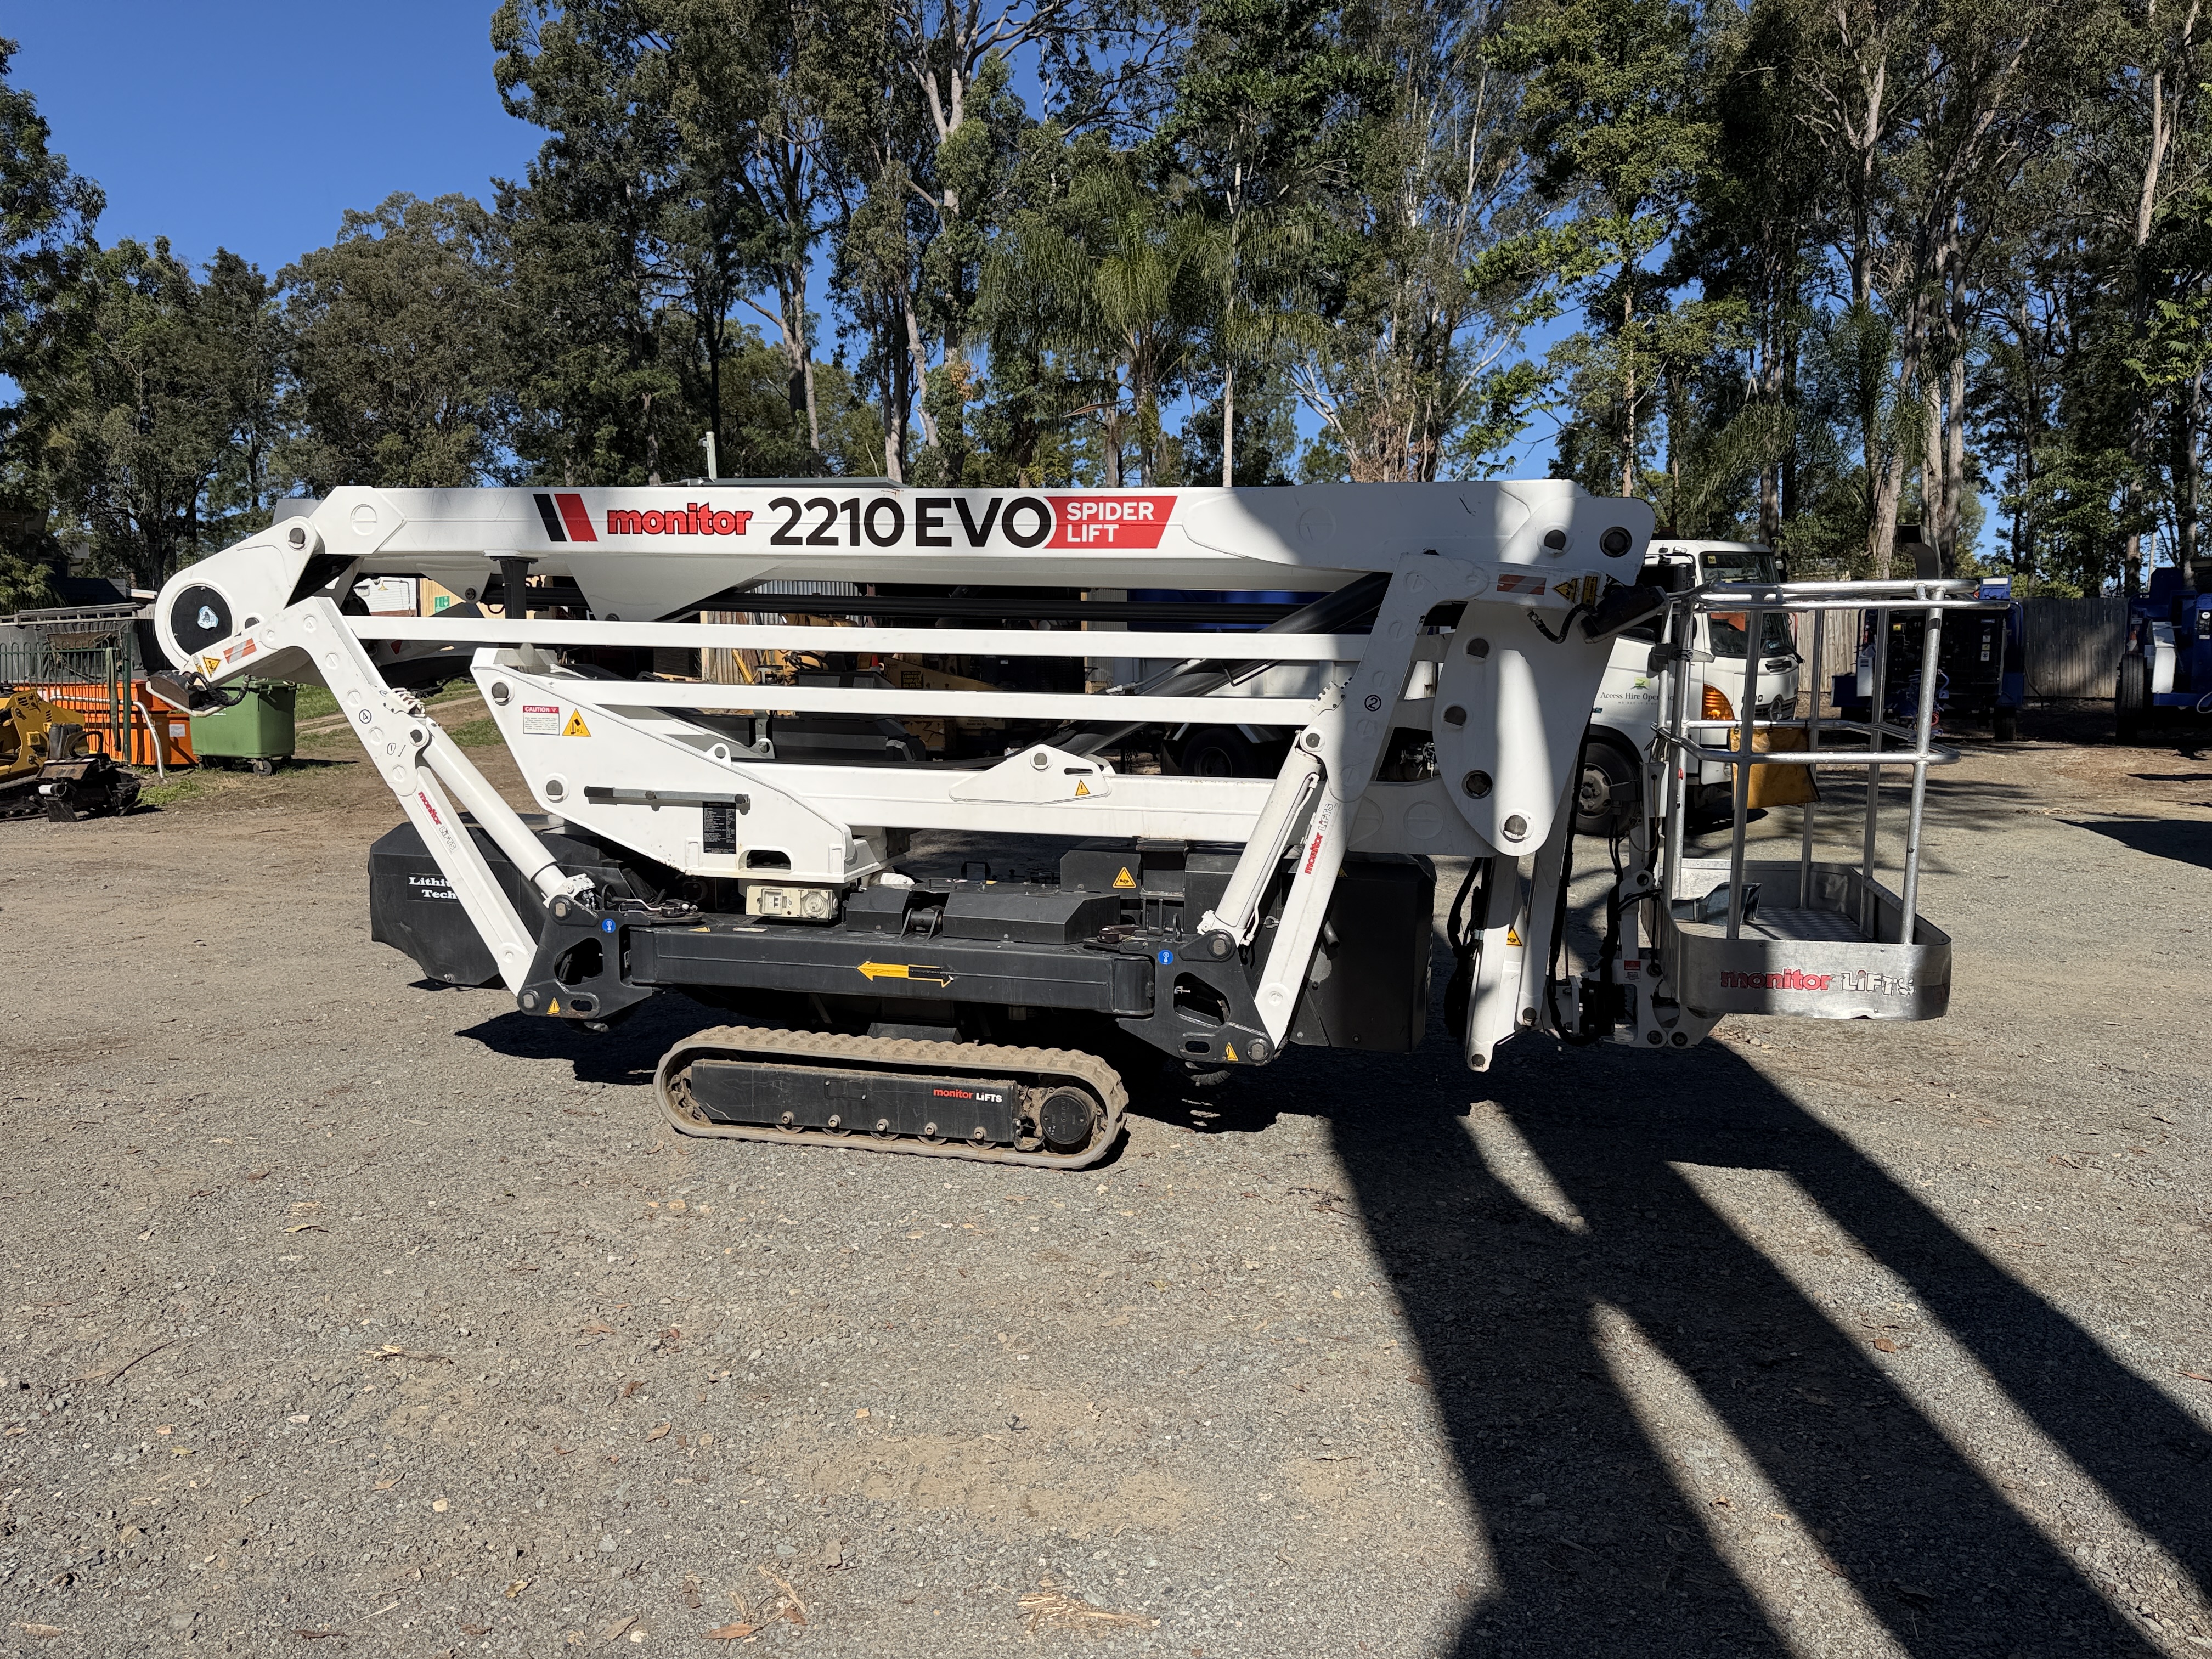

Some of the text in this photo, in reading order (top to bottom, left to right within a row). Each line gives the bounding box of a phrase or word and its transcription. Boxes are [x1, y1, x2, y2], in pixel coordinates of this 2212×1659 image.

[1066, 501, 1154, 521] SPIDER
[607, 496, 1052, 548] monitor 2210 EVO
[1067, 524, 1119, 543] LIFT
[418, 791, 442, 825] monitor
[1304, 832, 1323, 874] monitor
[409, 877, 451, 887] Lithiu
[421, 889, 458, 899] Tech
[1720, 967, 1833, 991] monitor
[933, 1089, 974, 1099] monitor
